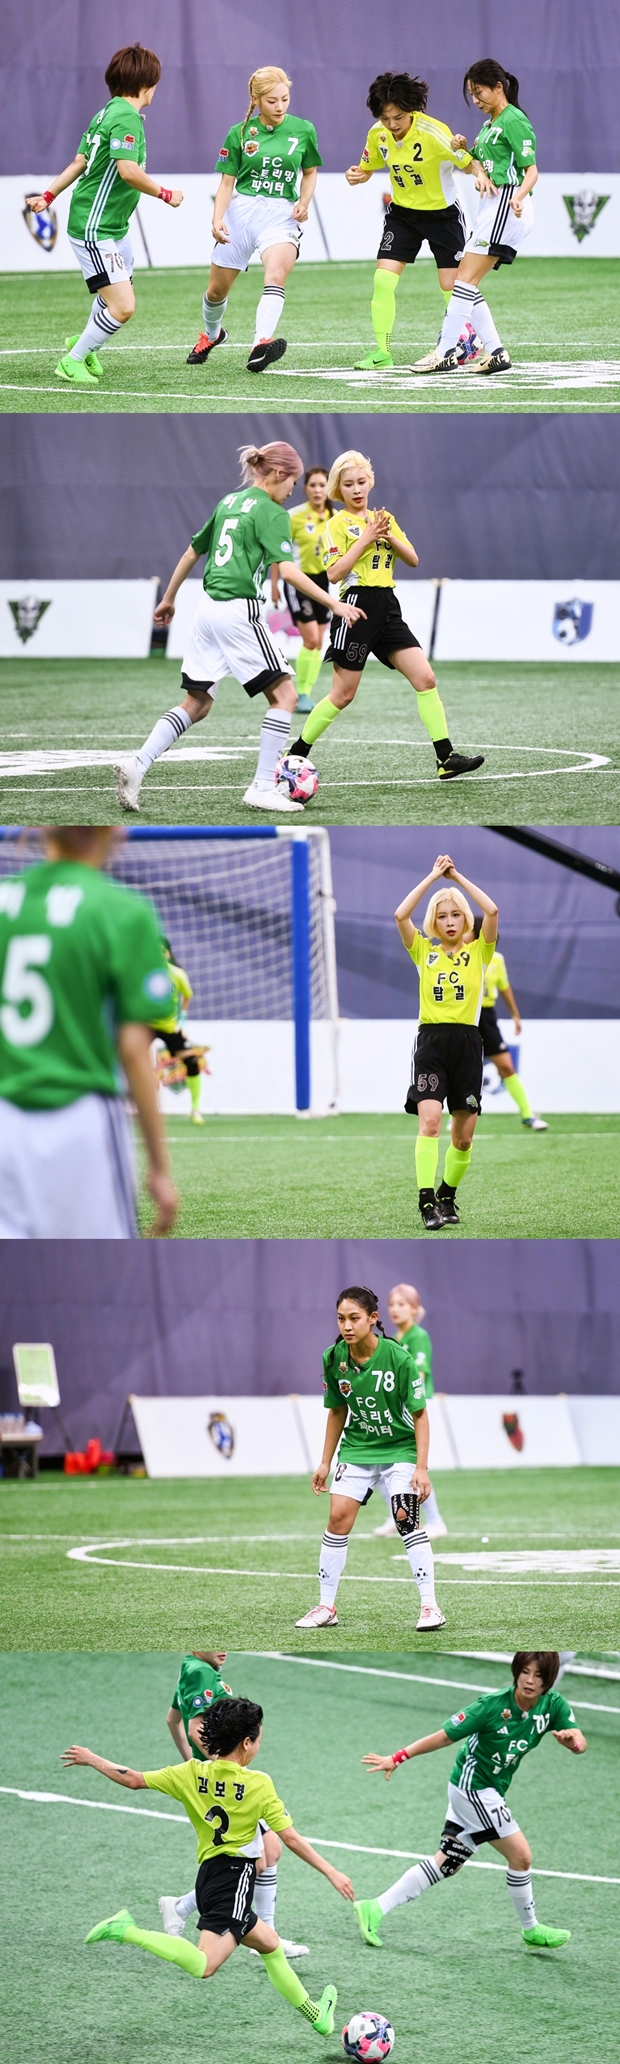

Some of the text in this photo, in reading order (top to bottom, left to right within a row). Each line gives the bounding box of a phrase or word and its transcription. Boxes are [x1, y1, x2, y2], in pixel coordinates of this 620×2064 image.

[287, 137, 299, 156] 7
[413, 142, 423, 162] 2
[262, 156, 283, 168] FC
[392, 164, 415, 174] FC
[250, 168, 295, 183] 스트리밍
[251, 180, 285, 196] 파이터
[381, 231, 394, 251] 2
[436, 353, 455, 370] NIKE
[488, 353, 506, 369] NIKE
[214, 518, 239, 567] 5
[375, 540, 392, 552] FC
[346, 642, 368, 664] 59
[437, 971, 460, 985] FC
[0, 935, 53, 1046] 5
[433, 985, 465, 1001] 탑걸
[417, 1073, 440, 1092] 59
[371, 1370, 395, 1392] 78
[356, 1396, 377, 1409] FC
[507, 1739, 529, 1752] FC
[197, 1776, 245, 1802] 김보경
[204, 1805, 230, 1847] 2
